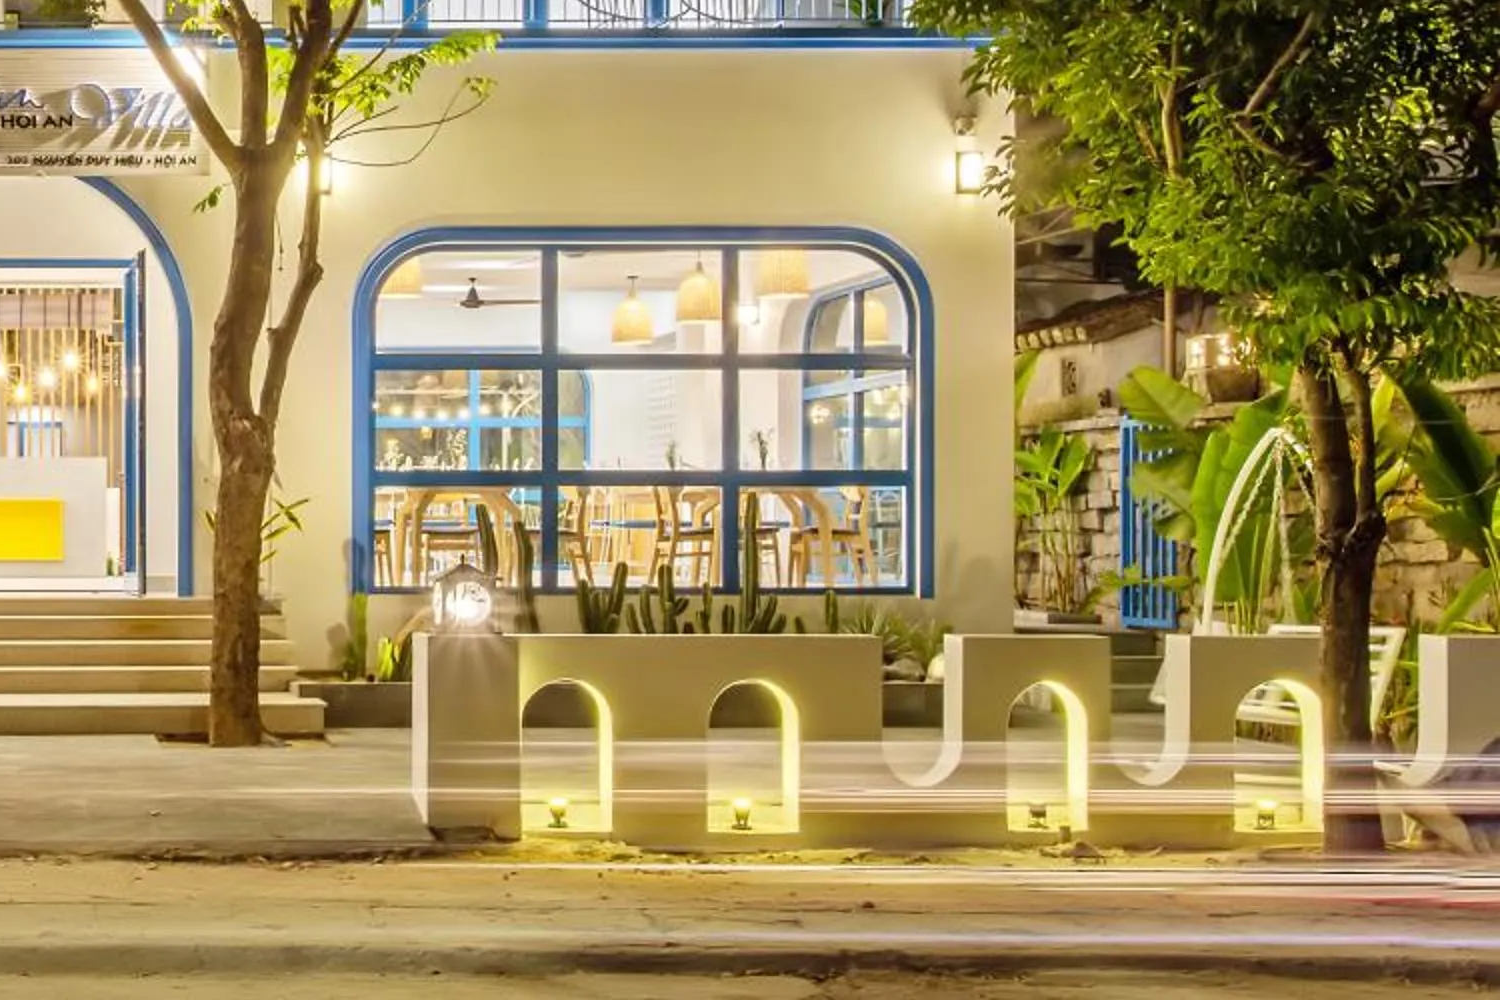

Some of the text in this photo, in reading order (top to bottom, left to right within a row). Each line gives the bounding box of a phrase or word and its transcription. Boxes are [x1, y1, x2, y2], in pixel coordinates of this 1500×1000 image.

[43, 114, 74, 129] AN
[86, 154, 111, 167] DUY
[179, 154, 198, 165] AN
